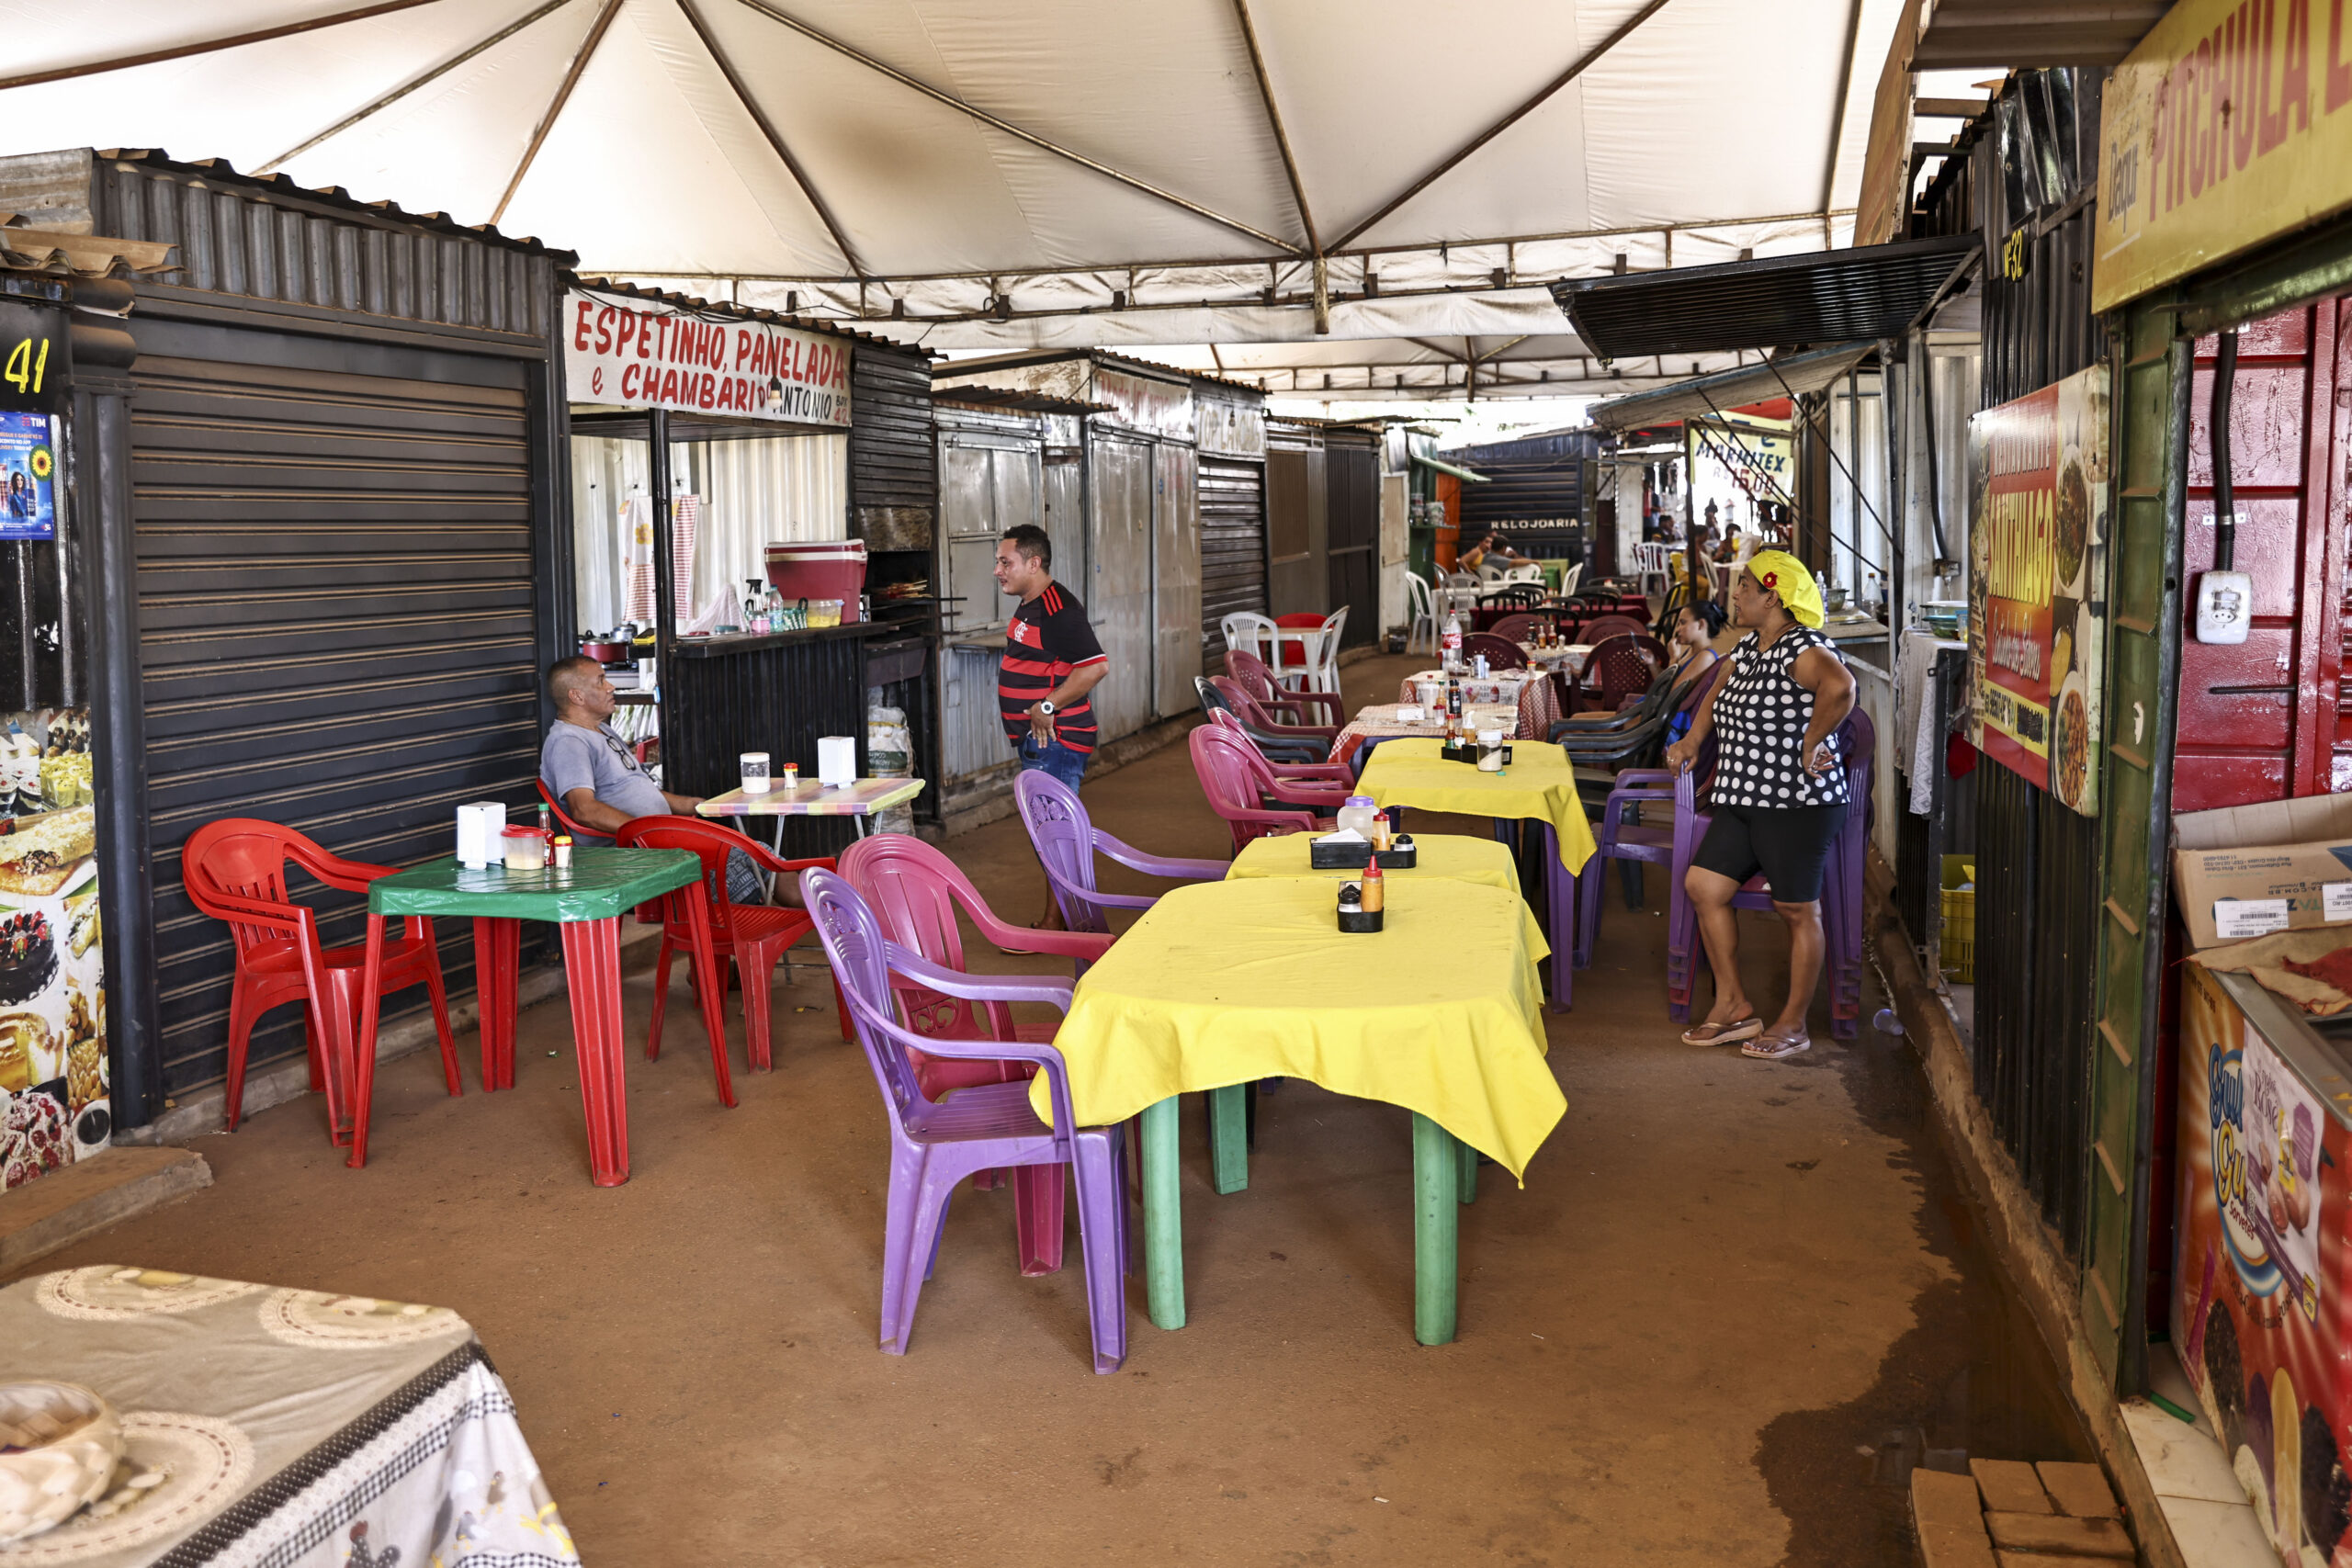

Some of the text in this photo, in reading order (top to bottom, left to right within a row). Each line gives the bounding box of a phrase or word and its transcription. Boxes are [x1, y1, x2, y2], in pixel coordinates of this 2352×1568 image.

[2149, 0, 2309, 222] PITCHULA
[5, 337, 50, 394] 41
[574, 300, 844, 389] ESPETINHO, PANELADA
[621, 364, 755, 412] CHAMBARI
[30, 417, 46, 428] TIM
[1696, 440, 1786, 473] MARMITEX
[1490, 518, 1578, 530] RELOJOARIA
[1988, 488, 2053, 609] SANTHIAGO
[2230, 1200, 2255, 1241] Sorvetes
